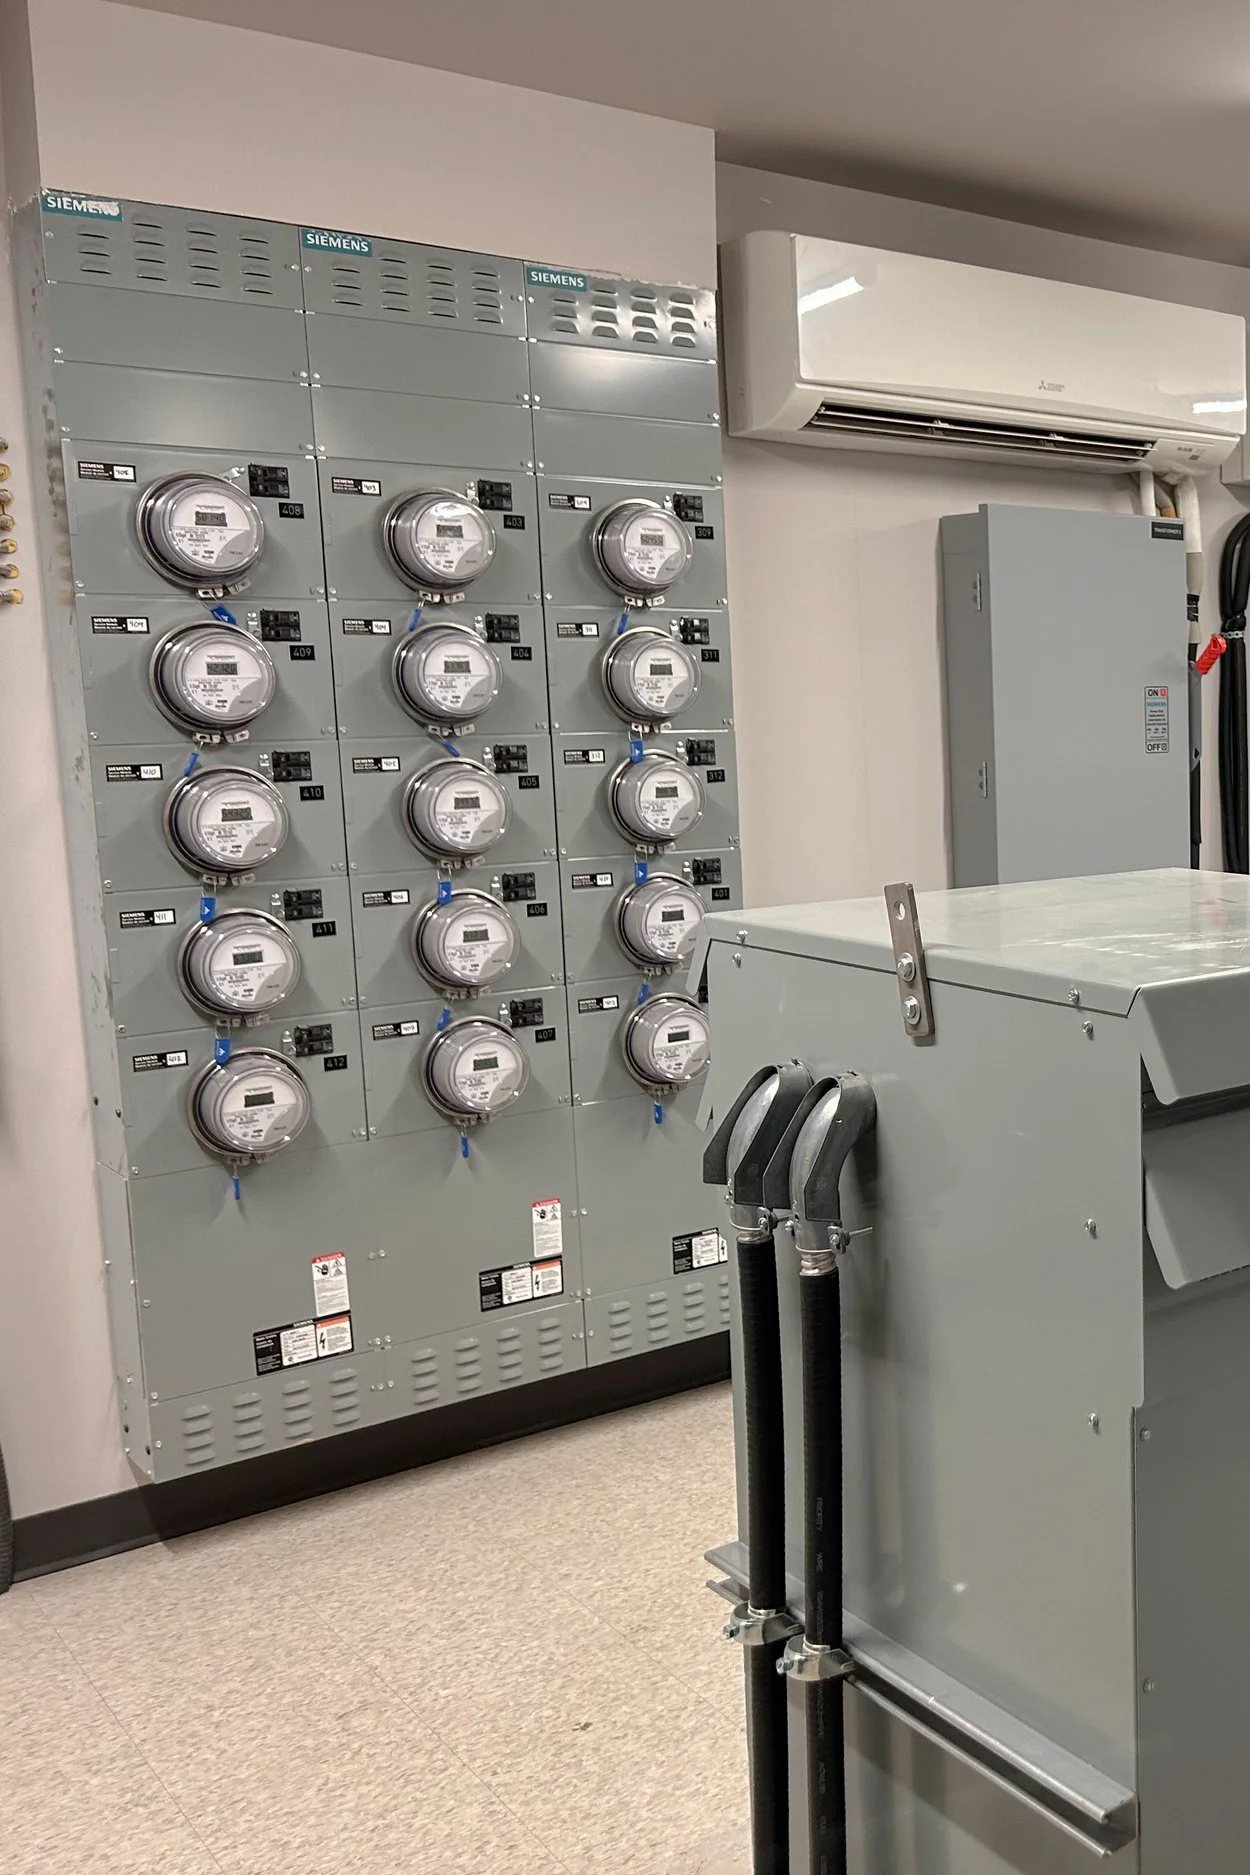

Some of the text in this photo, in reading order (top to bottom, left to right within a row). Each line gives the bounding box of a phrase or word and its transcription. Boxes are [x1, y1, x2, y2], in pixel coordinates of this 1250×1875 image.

[306, 233, 369, 252] SIEMENS
[530, 271, 585, 288] SIEMENS
[282, 505, 301, 516] 408
[506, 517, 522, 527] 403
[293, 647, 312, 657] 409
[513, 649, 529, 658] 404
[703, 650, 717, 660] 311
[1147, 688, 1159, 697] ON
[1146, 743, 1161, 751] OFF
[708, 771, 723, 781] 312
[521, 777, 537, 787] 405
[303, 787, 322, 798] 410
[714, 889, 728, 898] 401
[529, 904, 545, 914] 406
[315, 923, 333, 933] 411
[537, 1029, 553, 1039] 407
[326, 1057, 345, 1067] 412
